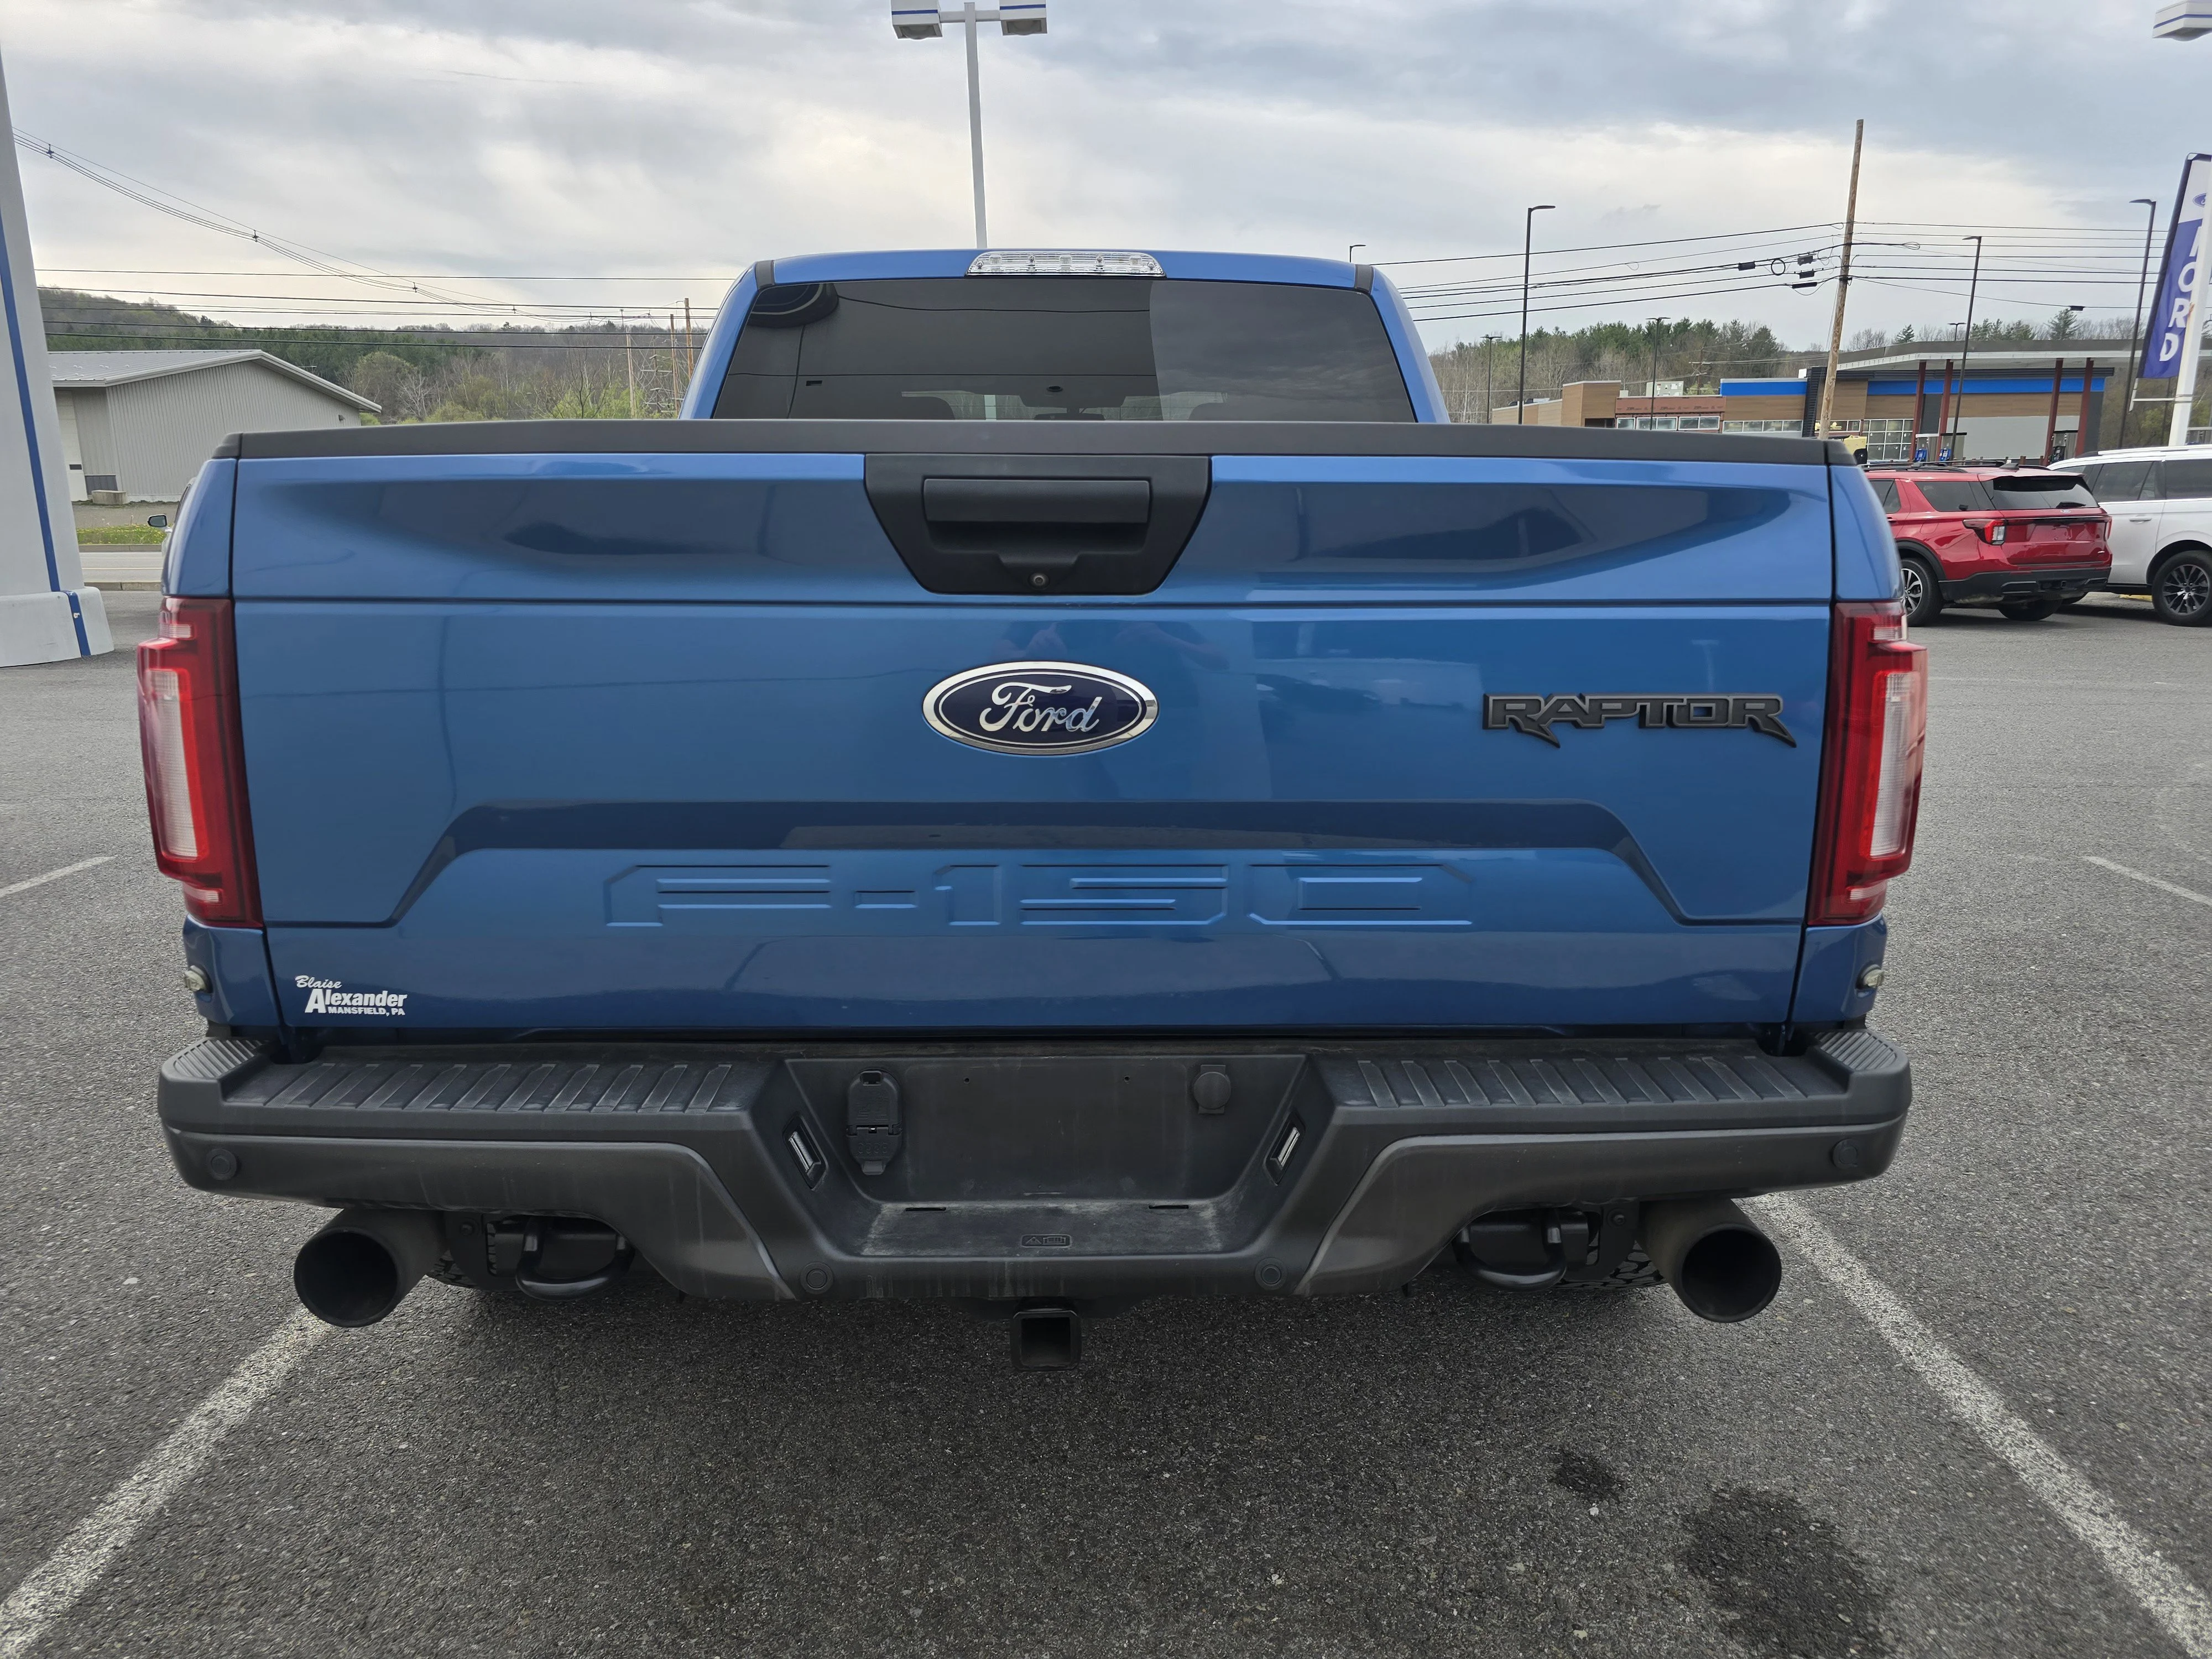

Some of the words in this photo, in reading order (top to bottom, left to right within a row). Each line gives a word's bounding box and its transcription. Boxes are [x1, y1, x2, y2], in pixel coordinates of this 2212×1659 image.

[979, 682, 1102, 732] Ford
[1483, 693, 1797, 748] RAPTOR
[604, 864, 1472, 927] F-150
[295, 975, 342, 989] Blaise
[305, 989, 408, 1013] Alexander
[328, 1006, 390, 1016] MANSFIELD,
